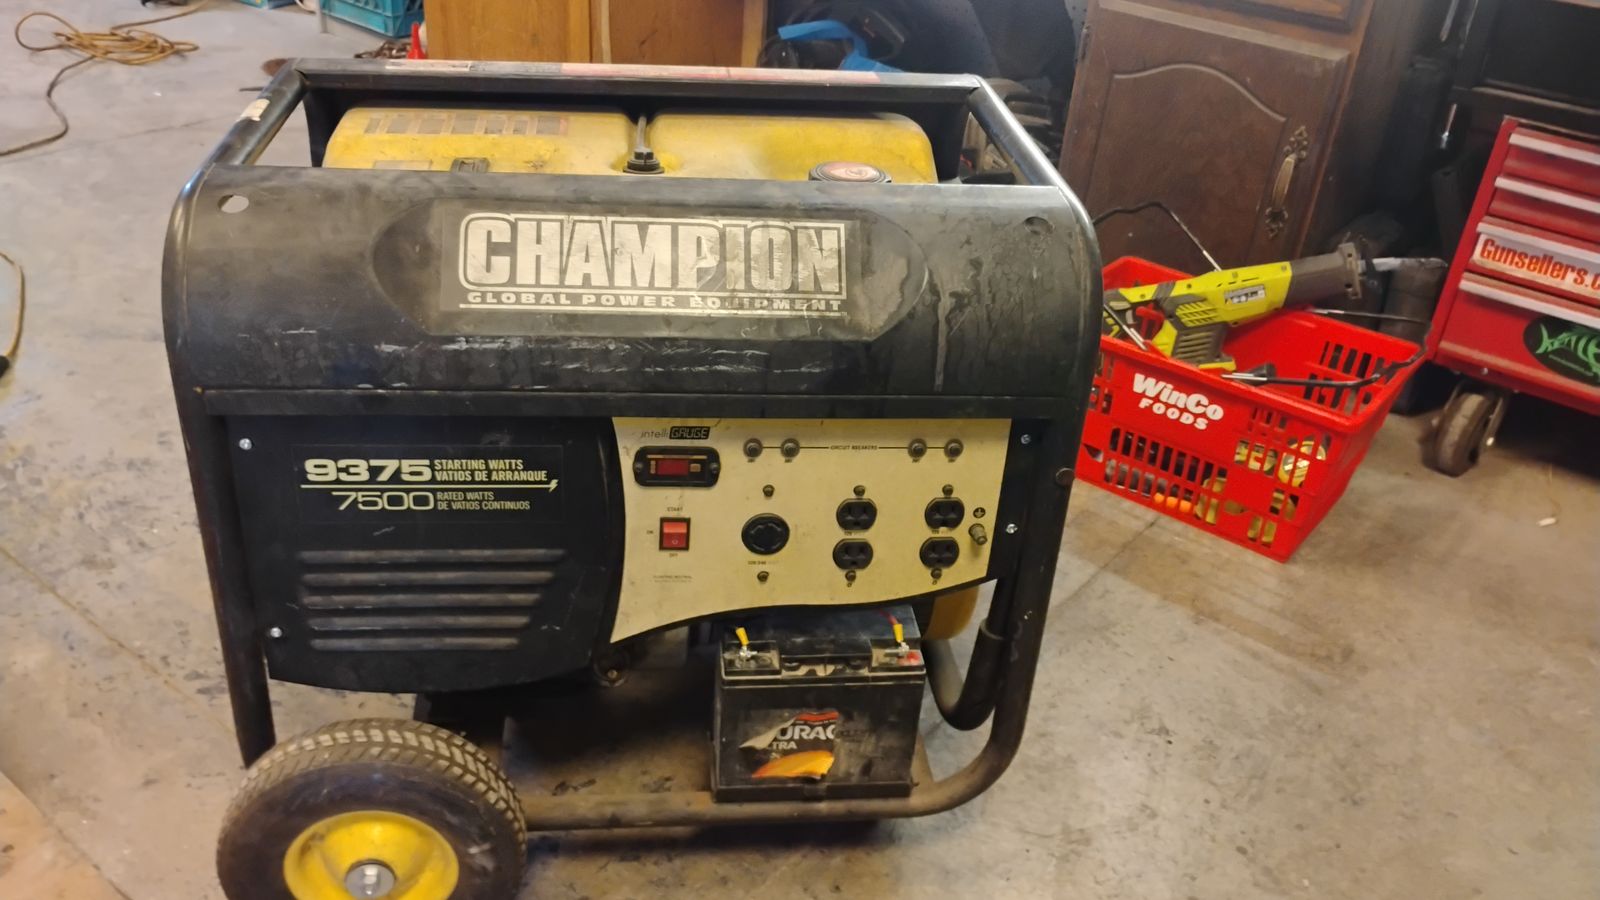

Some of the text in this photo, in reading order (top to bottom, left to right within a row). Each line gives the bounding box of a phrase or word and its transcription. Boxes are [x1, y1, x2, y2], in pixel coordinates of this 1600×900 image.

[465, 217, 840, 292] CHAMPION
[467, 291, 841, 311] GLOBAL POWER EQUIPMENT
[1133, 373, 1224, 420] WinCo
[1138, 397, 1209, 430] FOODS
[304, 459, 524, 482] 9375 STARTING WATTS
[434, 470, 548, 482] VATIOS DE ARRANQUE
[331, 491, 495, 511] 7500 RATED WATTS
[437, 500, 531, 510] DE VATIOS CONTINUOS
[768, 741, 797, 750] TRA
